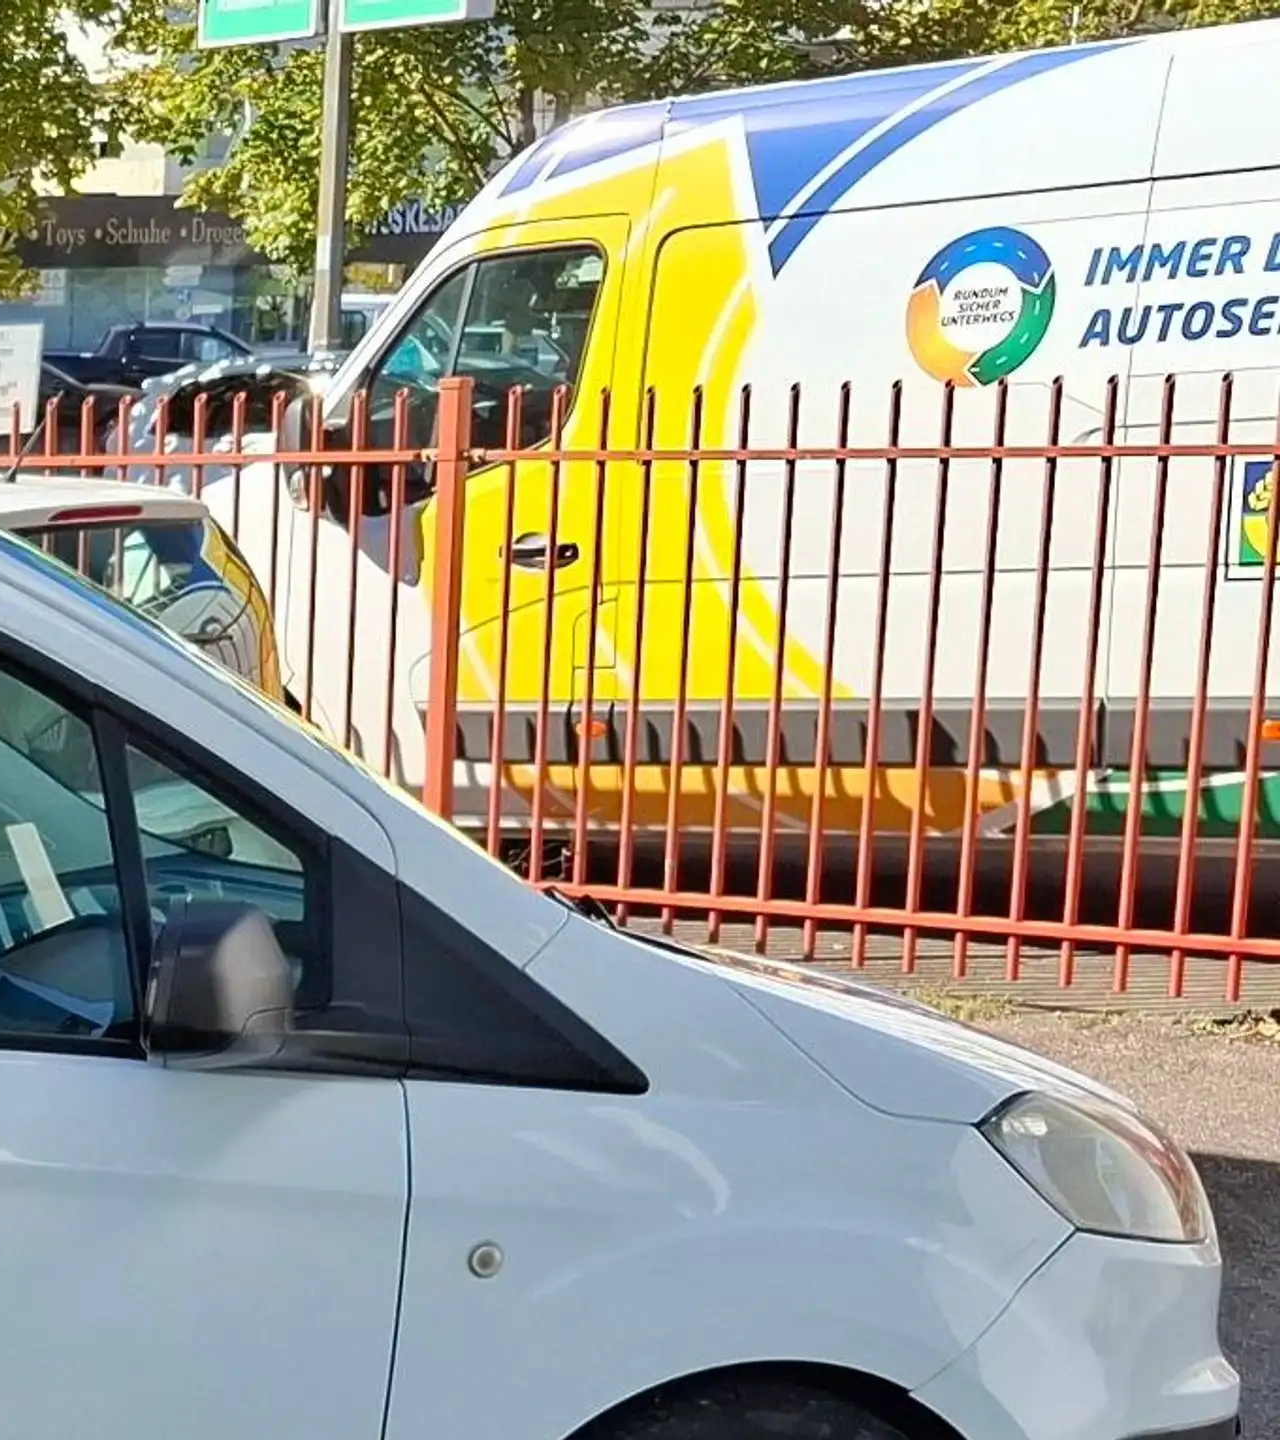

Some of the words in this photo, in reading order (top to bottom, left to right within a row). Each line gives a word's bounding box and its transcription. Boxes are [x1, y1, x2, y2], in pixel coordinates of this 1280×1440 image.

[41, 216, 86, 253] Toys
[105, 217, 172, 245] Schuhe
[1083, 235, 1252, 286] IMMER
[953, 286, 1009, 301] RUNDUM
[958, 300, 1001, 313] SICHER
[941, 310, 1017, 327] UNTERWEGS
[1078, 296, 1280, 348] AUTOSE
